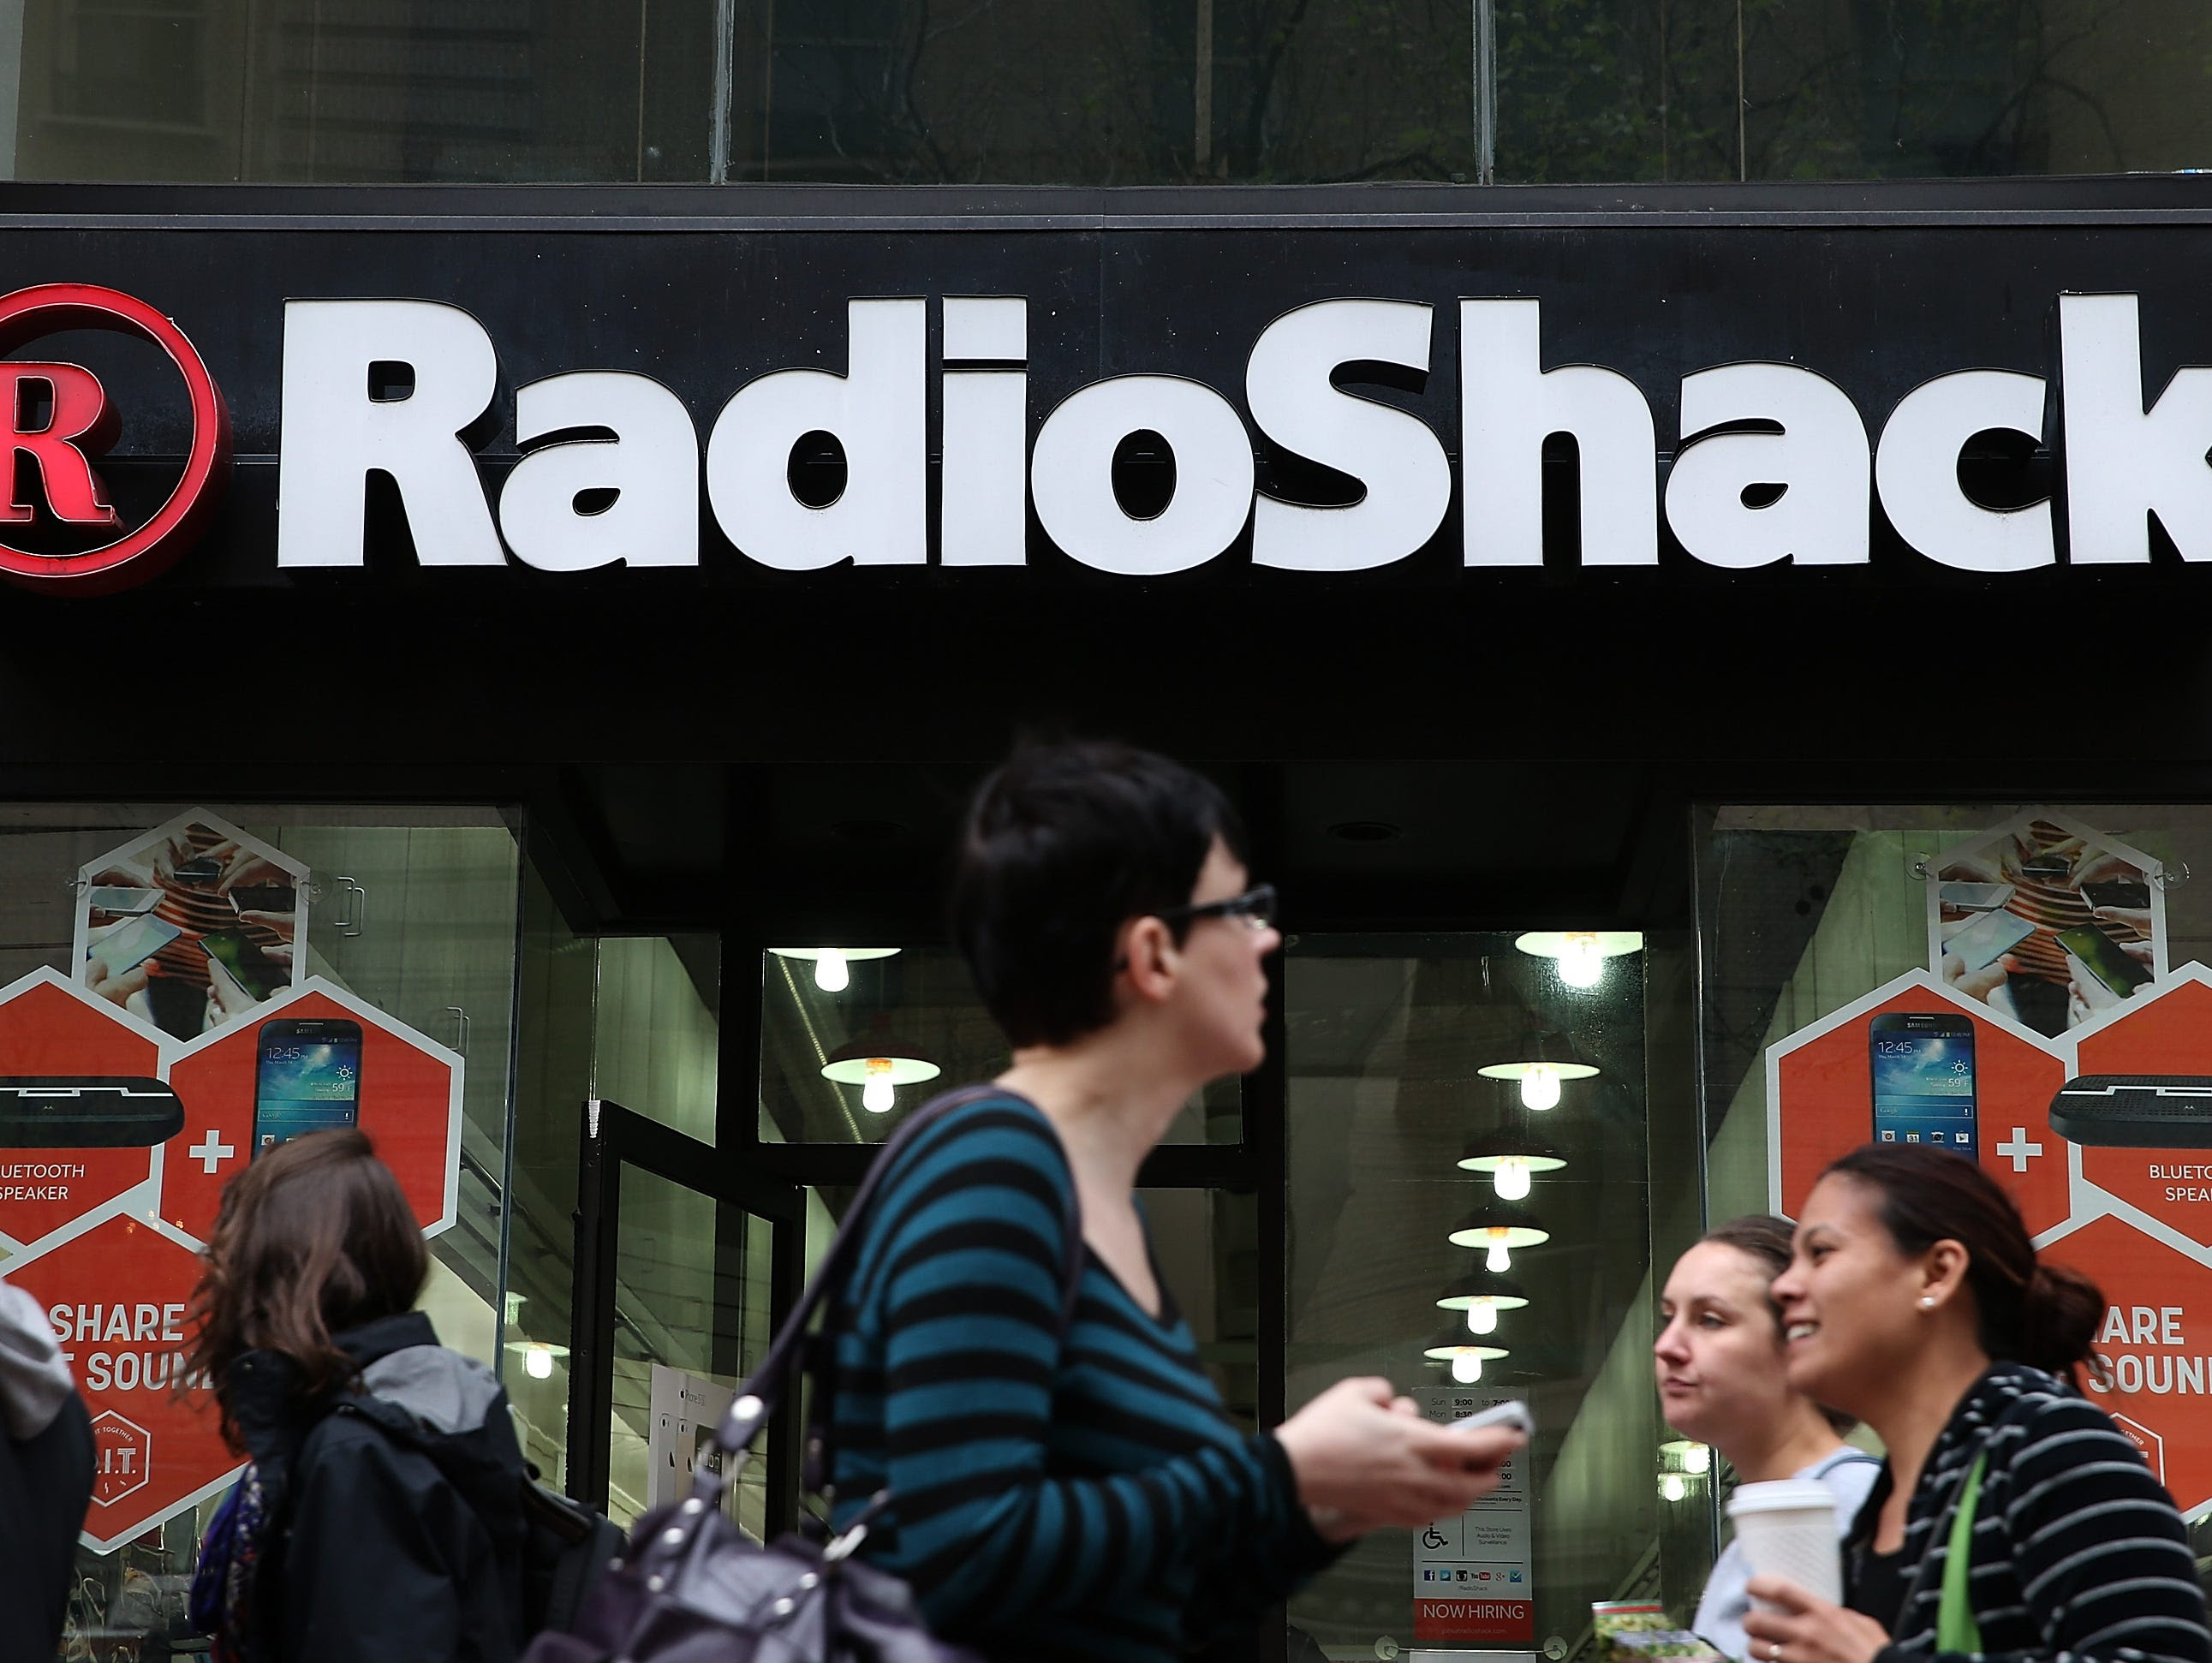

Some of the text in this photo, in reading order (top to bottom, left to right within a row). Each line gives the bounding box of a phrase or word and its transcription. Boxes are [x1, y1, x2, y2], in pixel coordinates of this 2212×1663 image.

[277, 292, 2212, 576] RadioShack
[267, 1047, 300, 1058] 12:45
[1878, 1041, 1913, 1053] 12:45
[332, 1082, 344, 1092] 59
[1948, 1077, 1961, 1088] 59
[0, 1164, 85, 1178] UETOOTH
[0, 1186, 69, 1200] PEAKER
[2165, 1187, 2212, 1201] SPEA
[48, 1303, 185, 1342] SHARE
[2088, 1353, 2212, 1394] SOUN
[1431, 1398, 1446, 1406] Sun
[102, 1426, 134, 1443] TOGETHER
[92, 1447, 137, 1475] .I.T.
[1423, 1604, 1524, 1619] NOW HIRING
